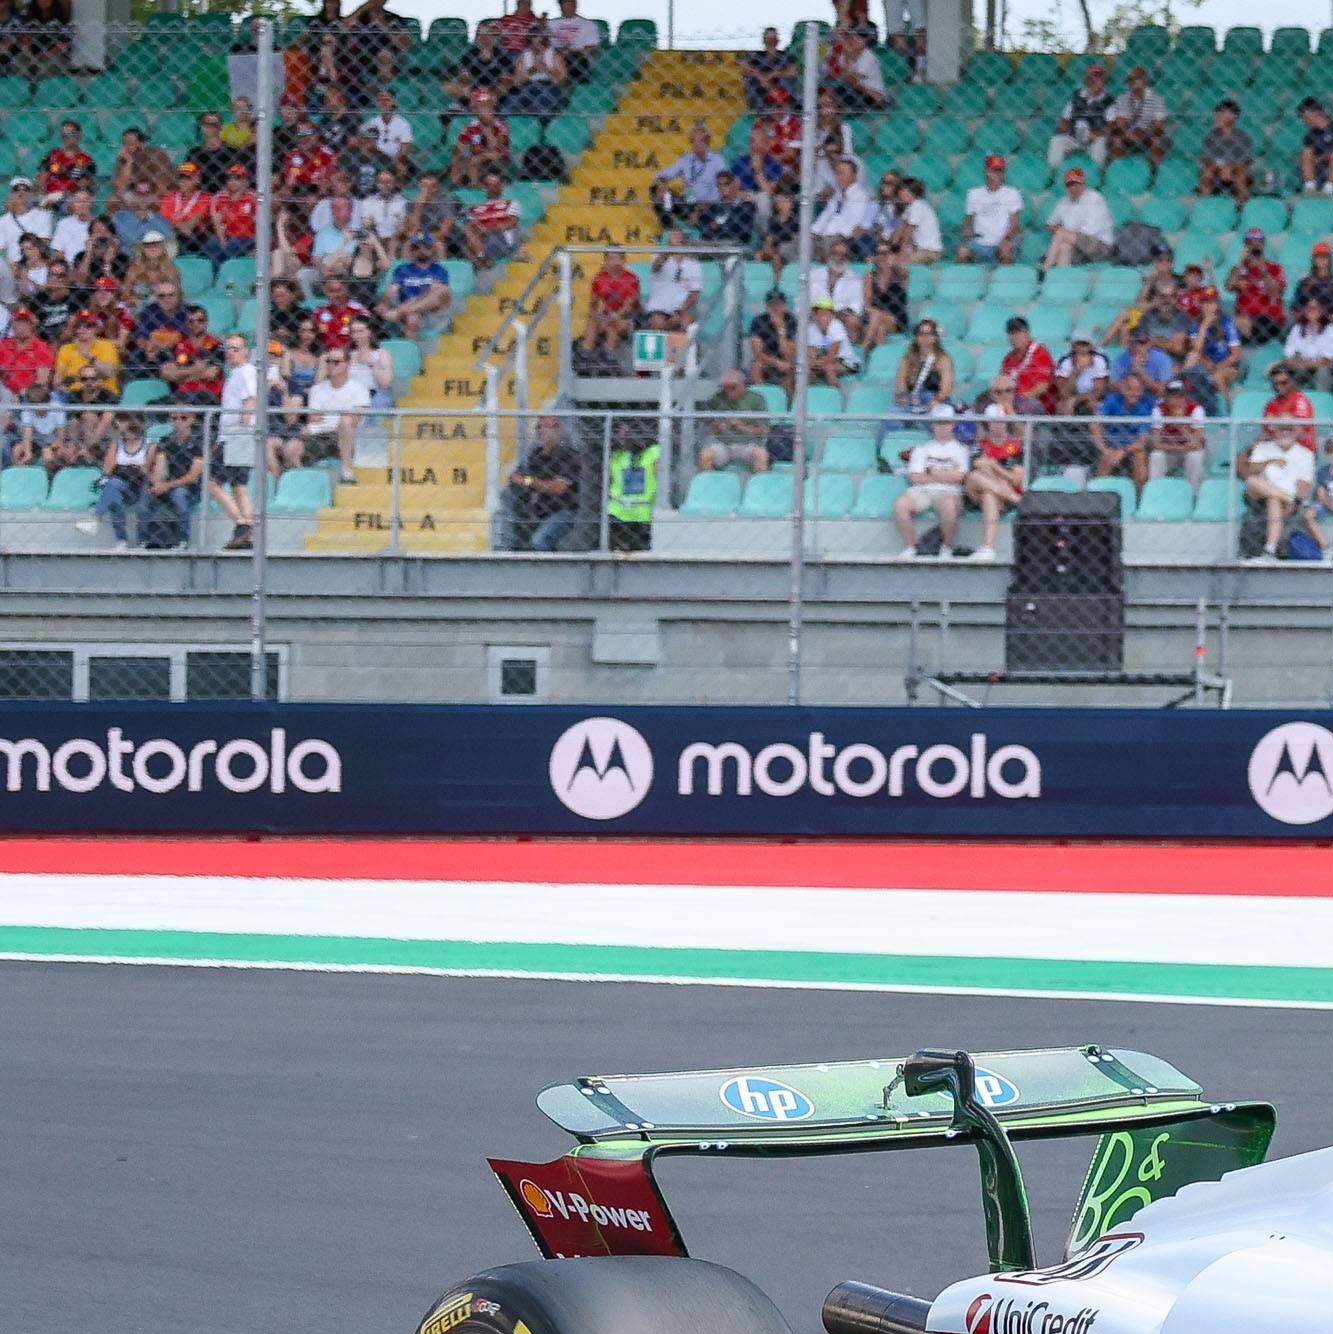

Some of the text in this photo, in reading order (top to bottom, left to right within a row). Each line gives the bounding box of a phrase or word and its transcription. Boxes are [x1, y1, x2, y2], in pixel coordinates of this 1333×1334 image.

[420, 513, 437, 530] A
[678, 732, 1041, 798] motorola
[546, 1189, 653, 1232] V-Power
